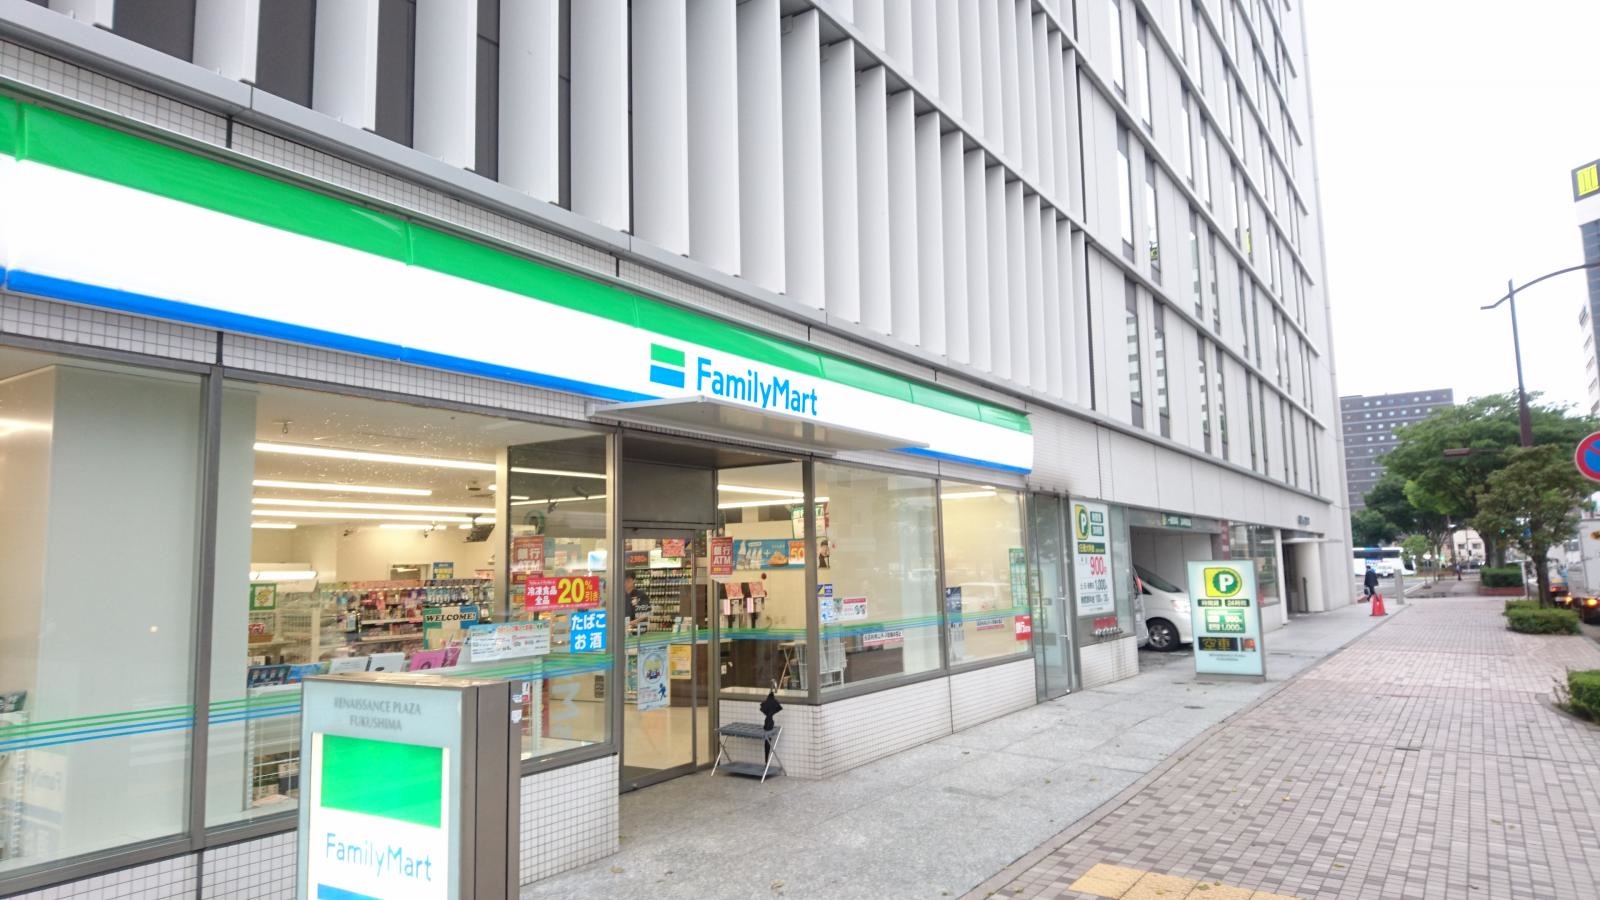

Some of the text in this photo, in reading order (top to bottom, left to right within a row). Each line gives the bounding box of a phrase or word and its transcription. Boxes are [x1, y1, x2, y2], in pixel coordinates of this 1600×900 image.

[697, 357, 818, 416] FamilyMart
[713, 556, 731, 565] ATM
[527, 586, 558, 596] 冷凍食品
[535, 596, 550, 606] 全品
[426, 613, 476, 622] WELCOME!
[572, 614, 606, 631] たばこ
[574, 632, 603, 650] お酒
[334, 697, 421, 715] RENAISSANCE PLAZA
[350, 716, 402, 730] FUKUSHIMA
[326, 832, 432, 881] FamilyMart
